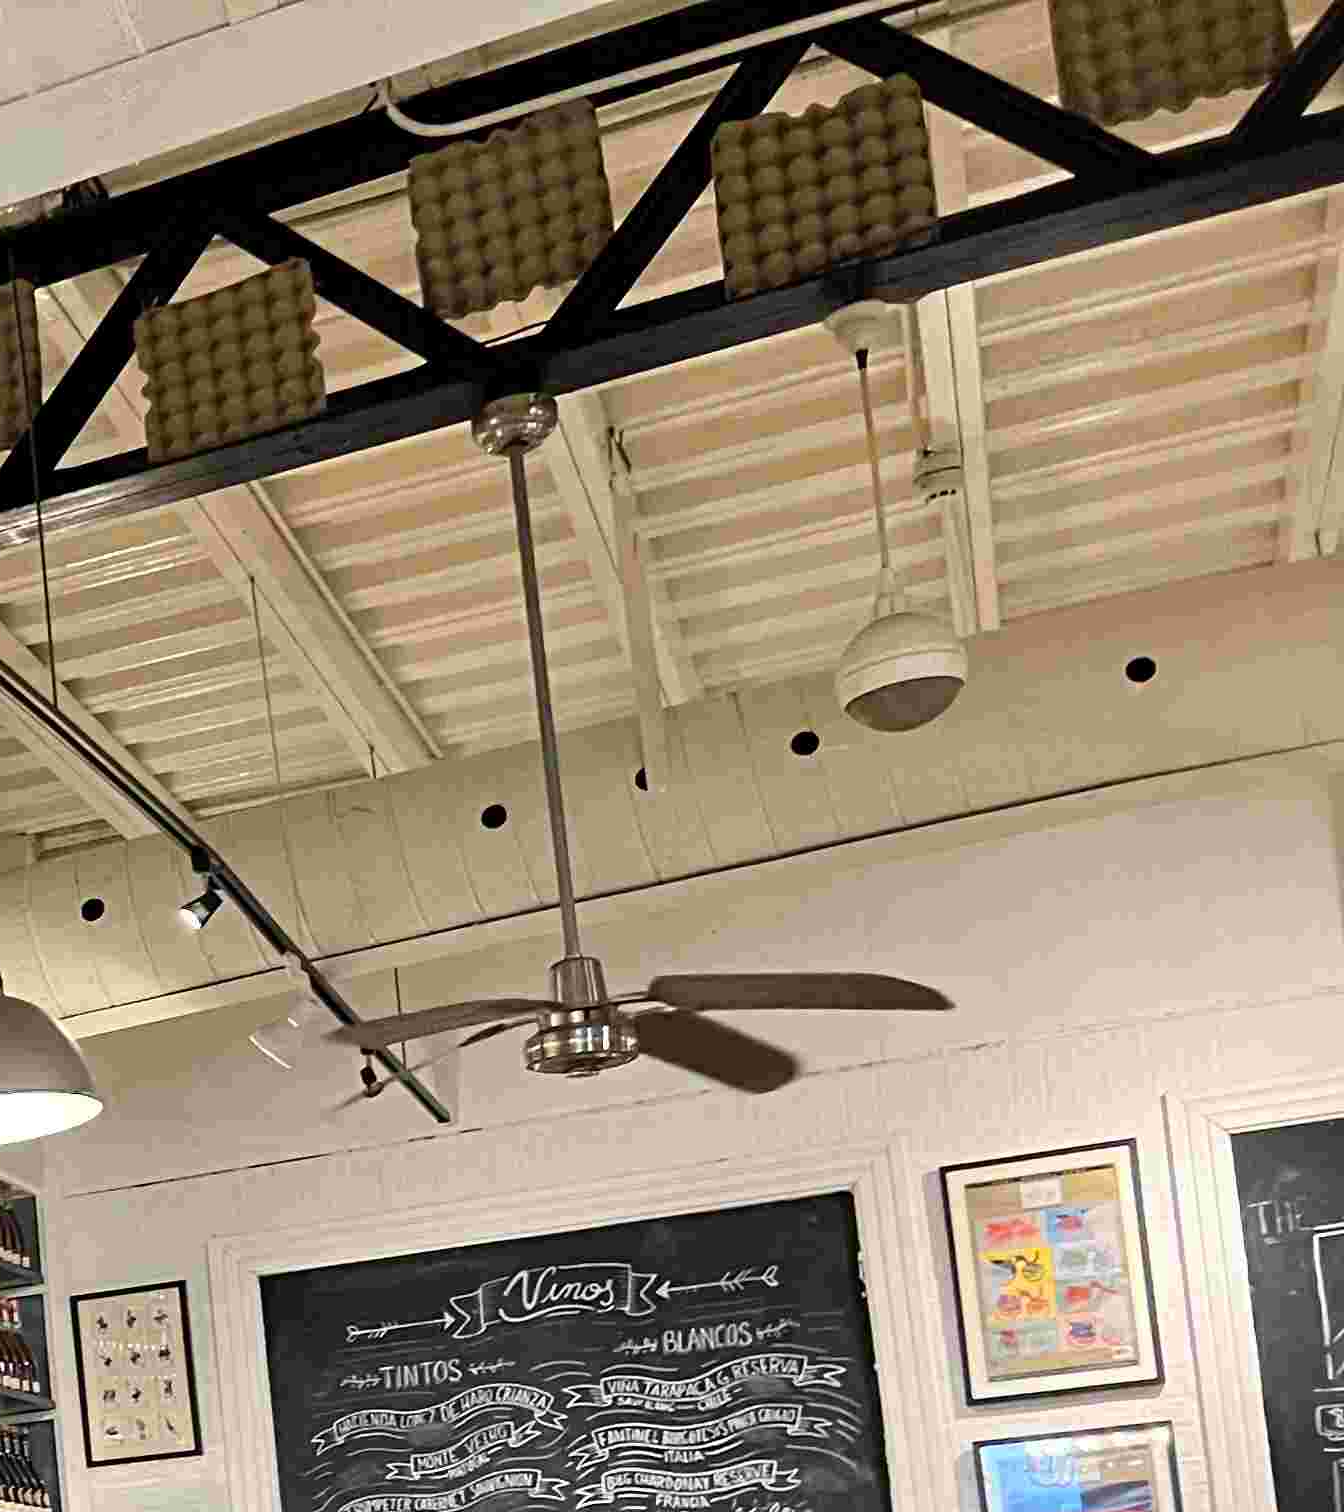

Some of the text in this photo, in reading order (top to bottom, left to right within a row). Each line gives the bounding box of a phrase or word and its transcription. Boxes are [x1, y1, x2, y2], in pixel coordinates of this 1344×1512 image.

[504, 1266, 614, 1310] Vinos
[663, 1321, 753, 1353] BLANCOS
[378, 1358, 463, 1389] TINTOS
[730, 1356, 799, 1379] RESERVA
[663, 1450, 705, 1464] ITALIA
